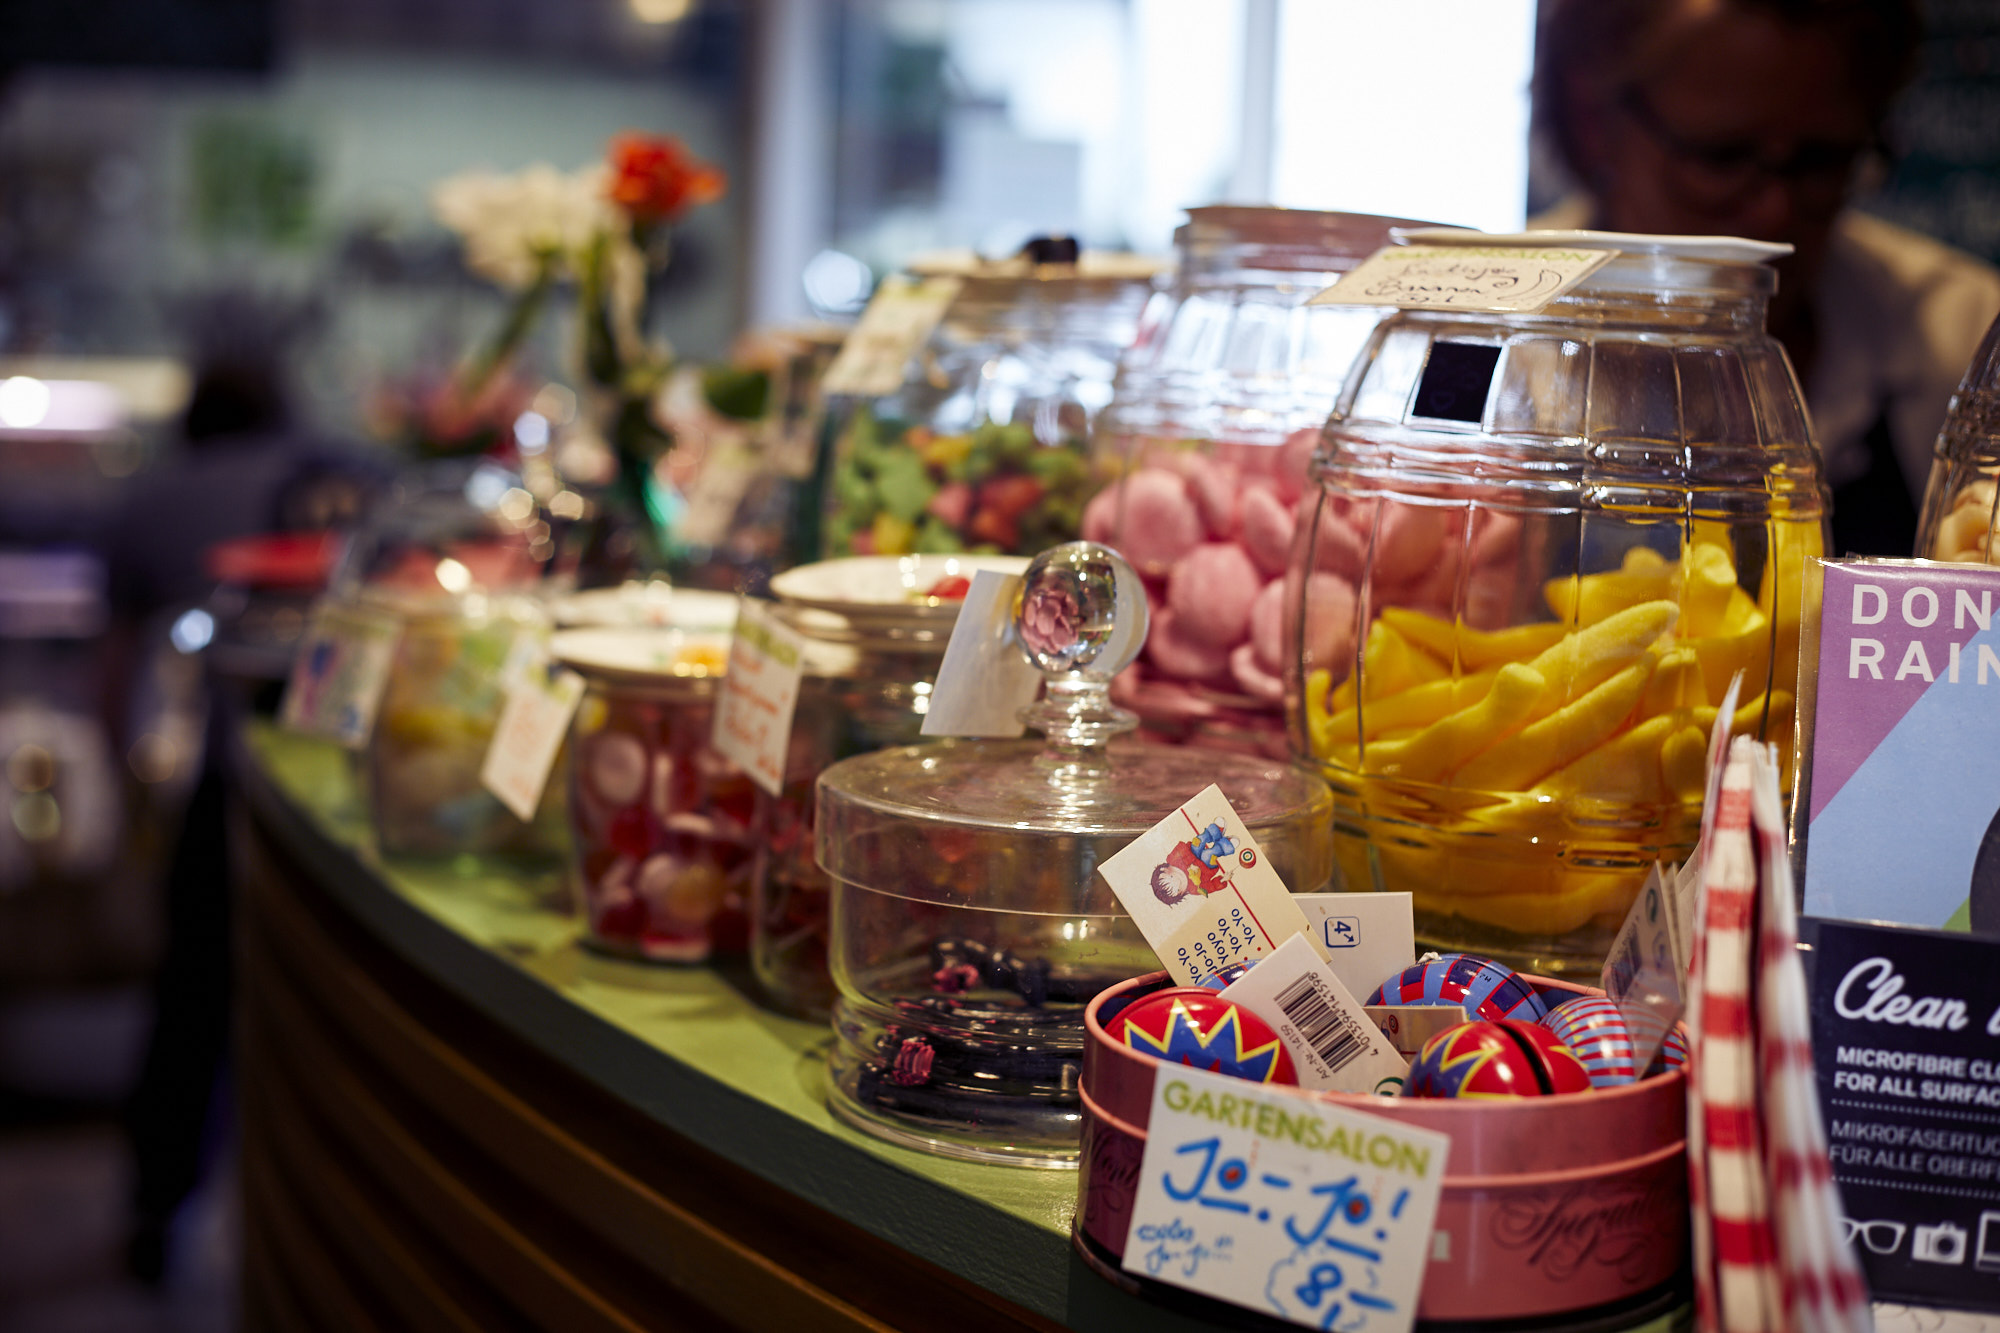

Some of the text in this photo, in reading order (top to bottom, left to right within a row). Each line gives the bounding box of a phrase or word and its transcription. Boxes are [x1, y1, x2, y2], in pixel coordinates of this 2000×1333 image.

[1851, 583, 1992, 631] DON
[1848, 637, 2000, 686] RAIN
[1218, 918, 1243, 955] Yo-Yo
[1231, 908, 1256, 945] Yo-Yo
[1177, 947, 1202, 984] Yo-Yo
[1194, 942, 1218, 973] Jo-Jo
[1207, 932, 1229, 965] Yoyo
[1834, 956, 1970, 1031] Clean
[1836, 1045, 1968, 1079] MICROFIBRE
[1834, 1070, 2000, 1108] FOR ALL SURFAC
[1162, 1079, 1431, 1180] GARTENSALON
[1829, 1142, 1871, 1166] FÜR
[1873, 1150, 1924, 1173] ALLE
